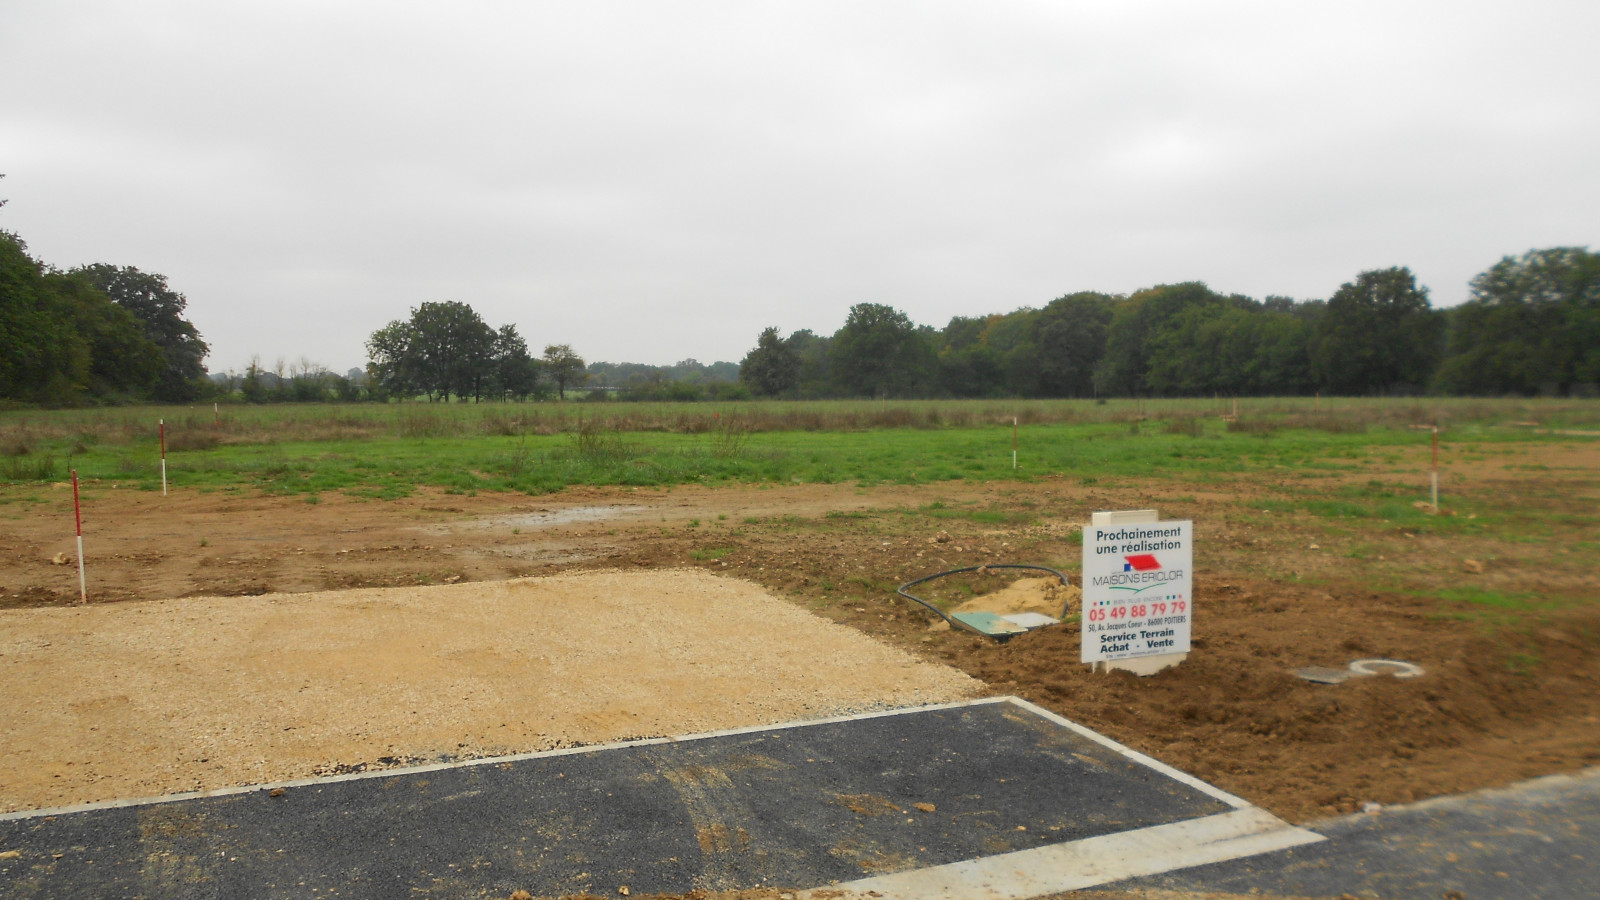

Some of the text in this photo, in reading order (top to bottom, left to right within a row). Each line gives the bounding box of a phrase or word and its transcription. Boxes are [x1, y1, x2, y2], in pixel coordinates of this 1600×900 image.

[1096, 527, 1181, 541] Prochainement
[1096, 539, 1181, 554] une réalisation
[1093, 570, 1183, 586] MAISONS ERICLOR
[1089, 601, 1186, 621] 05 49 88 79 79
[1164, 616, 1186, 624] POITIERS
[1100, 628, 1174, 643] Service Terrain
[1100, 642, 1130, 653] Achat
[1146, 639, 1174, 648] Vente
